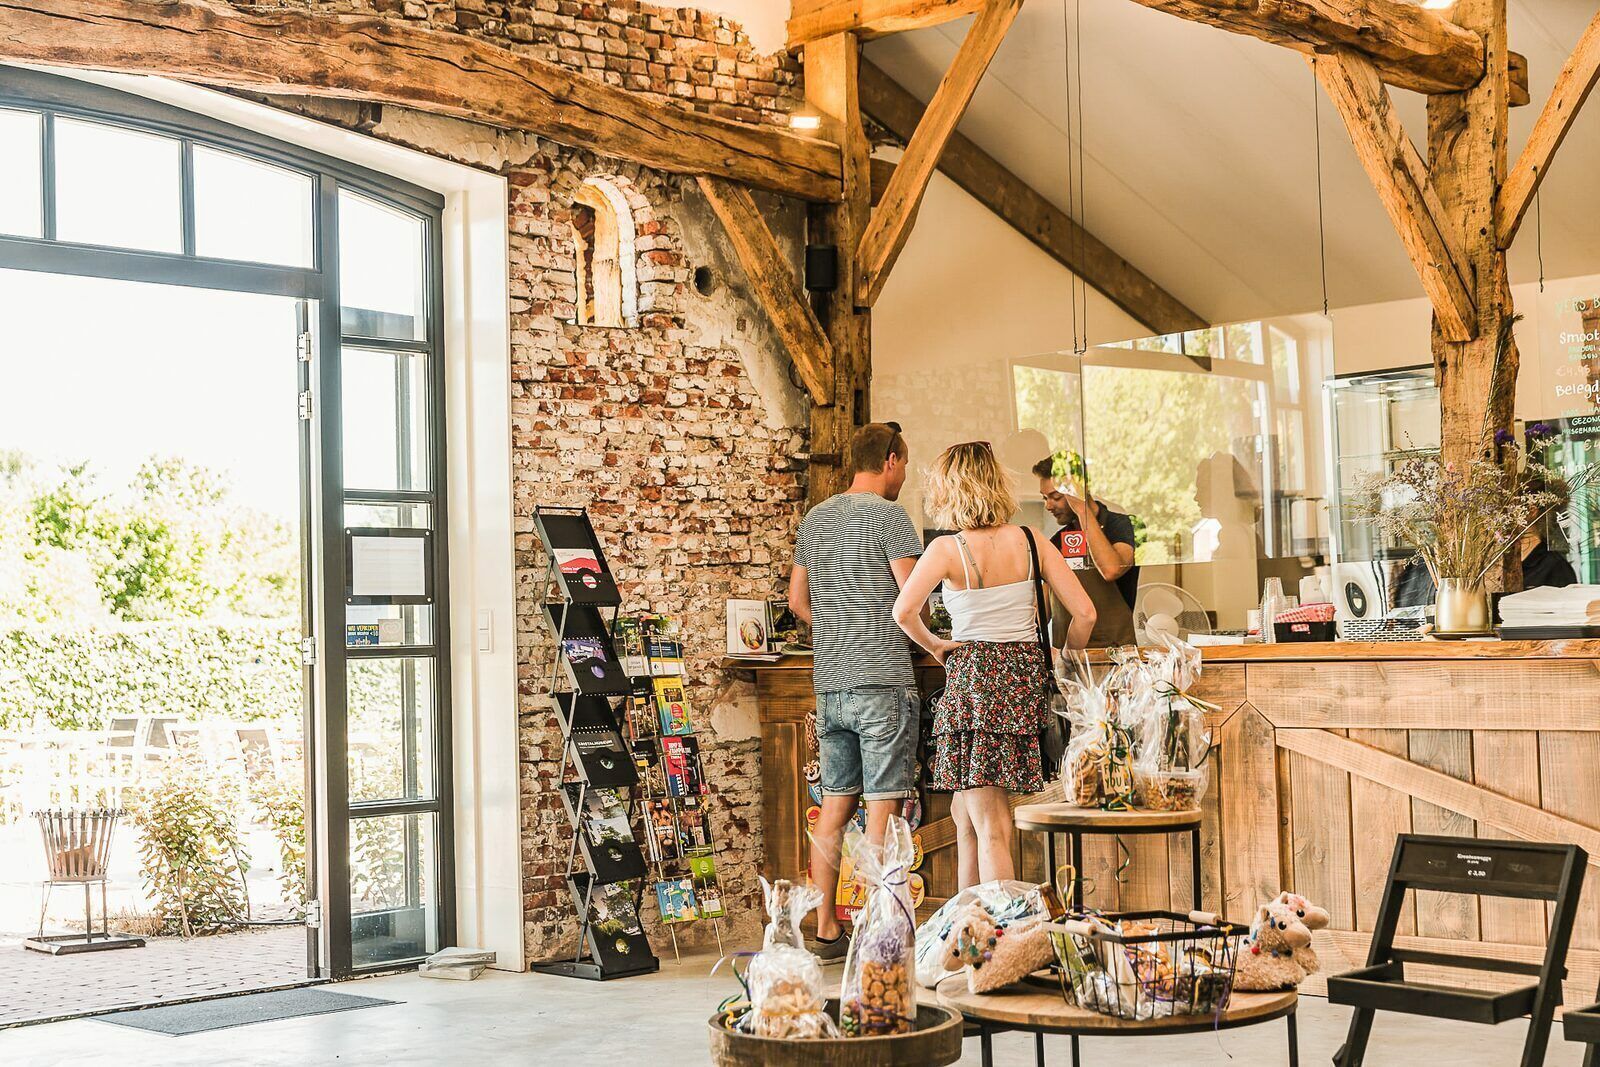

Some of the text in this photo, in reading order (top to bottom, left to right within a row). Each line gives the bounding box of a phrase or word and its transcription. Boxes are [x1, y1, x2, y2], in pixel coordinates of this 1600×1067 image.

[1559, 329, 1600, 344] Smoot
[1555, 380, 1600, 399] Belegd
[1104, 764, 1120, 774] FR
[1105, 777, 1122, 789] YOU
